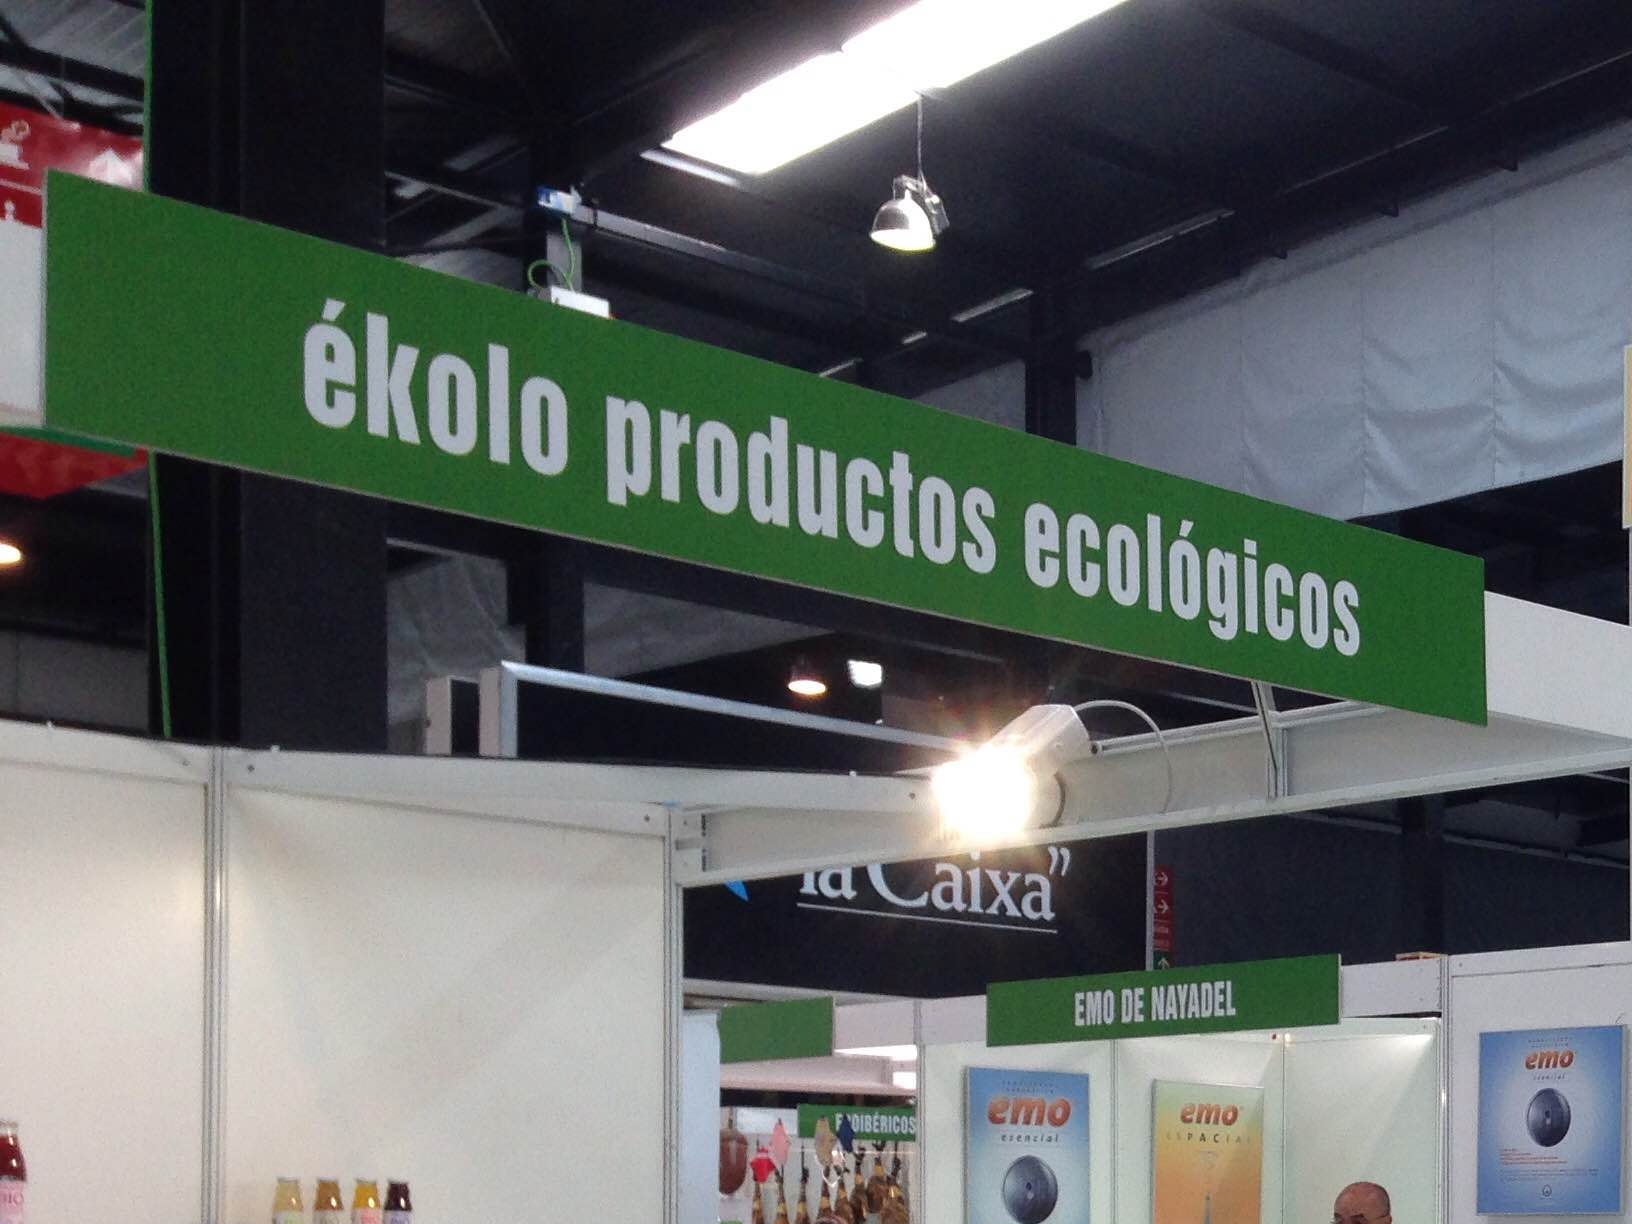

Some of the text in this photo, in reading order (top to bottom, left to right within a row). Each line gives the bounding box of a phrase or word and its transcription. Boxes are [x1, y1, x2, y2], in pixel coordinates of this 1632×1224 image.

[304, 299, 1361, 658] ékolo productos ecológicos
[1074, 981, 1236, 1027] EMO DE NAYADEL
[1524, 1050, 1574, 1070] emo
[987, 1096, 1071, 1128] emo
[1180, 1103, 1239, 1127] emo
